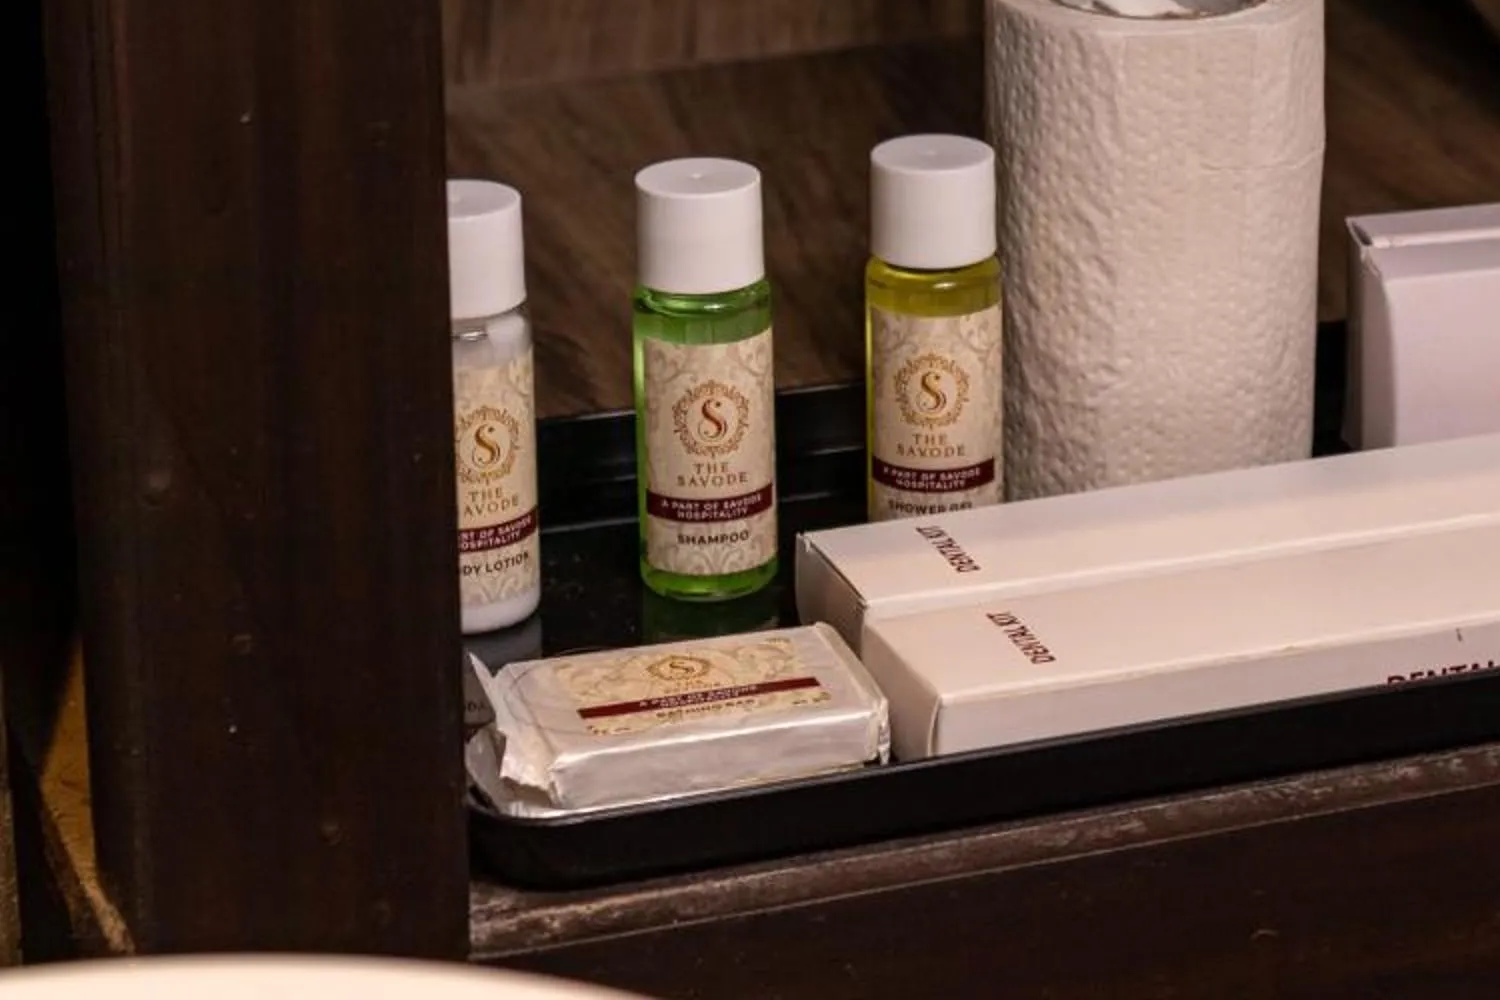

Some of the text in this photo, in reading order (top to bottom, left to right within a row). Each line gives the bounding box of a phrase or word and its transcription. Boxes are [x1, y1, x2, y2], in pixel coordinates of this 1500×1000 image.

[697, 399, 727, 442] S
[471, 424, 501, 465] S
[912, 433, 948, 446] THE
[896, 443, 966, 458] SAVODE
[692, 461, 729, 475] THE
[677, 471, 749, 488] SAVODE
[468, 487, 503, 503] THE
[463, 494, 519, 518] AVODE
[460, 531, 521, 551] OSPITALITY
[676, 530, 749, 545] SHAMPOO
[463, 551, 529, 576] DY LOTION
[1003, 625, 1057, 665] DENTAL
